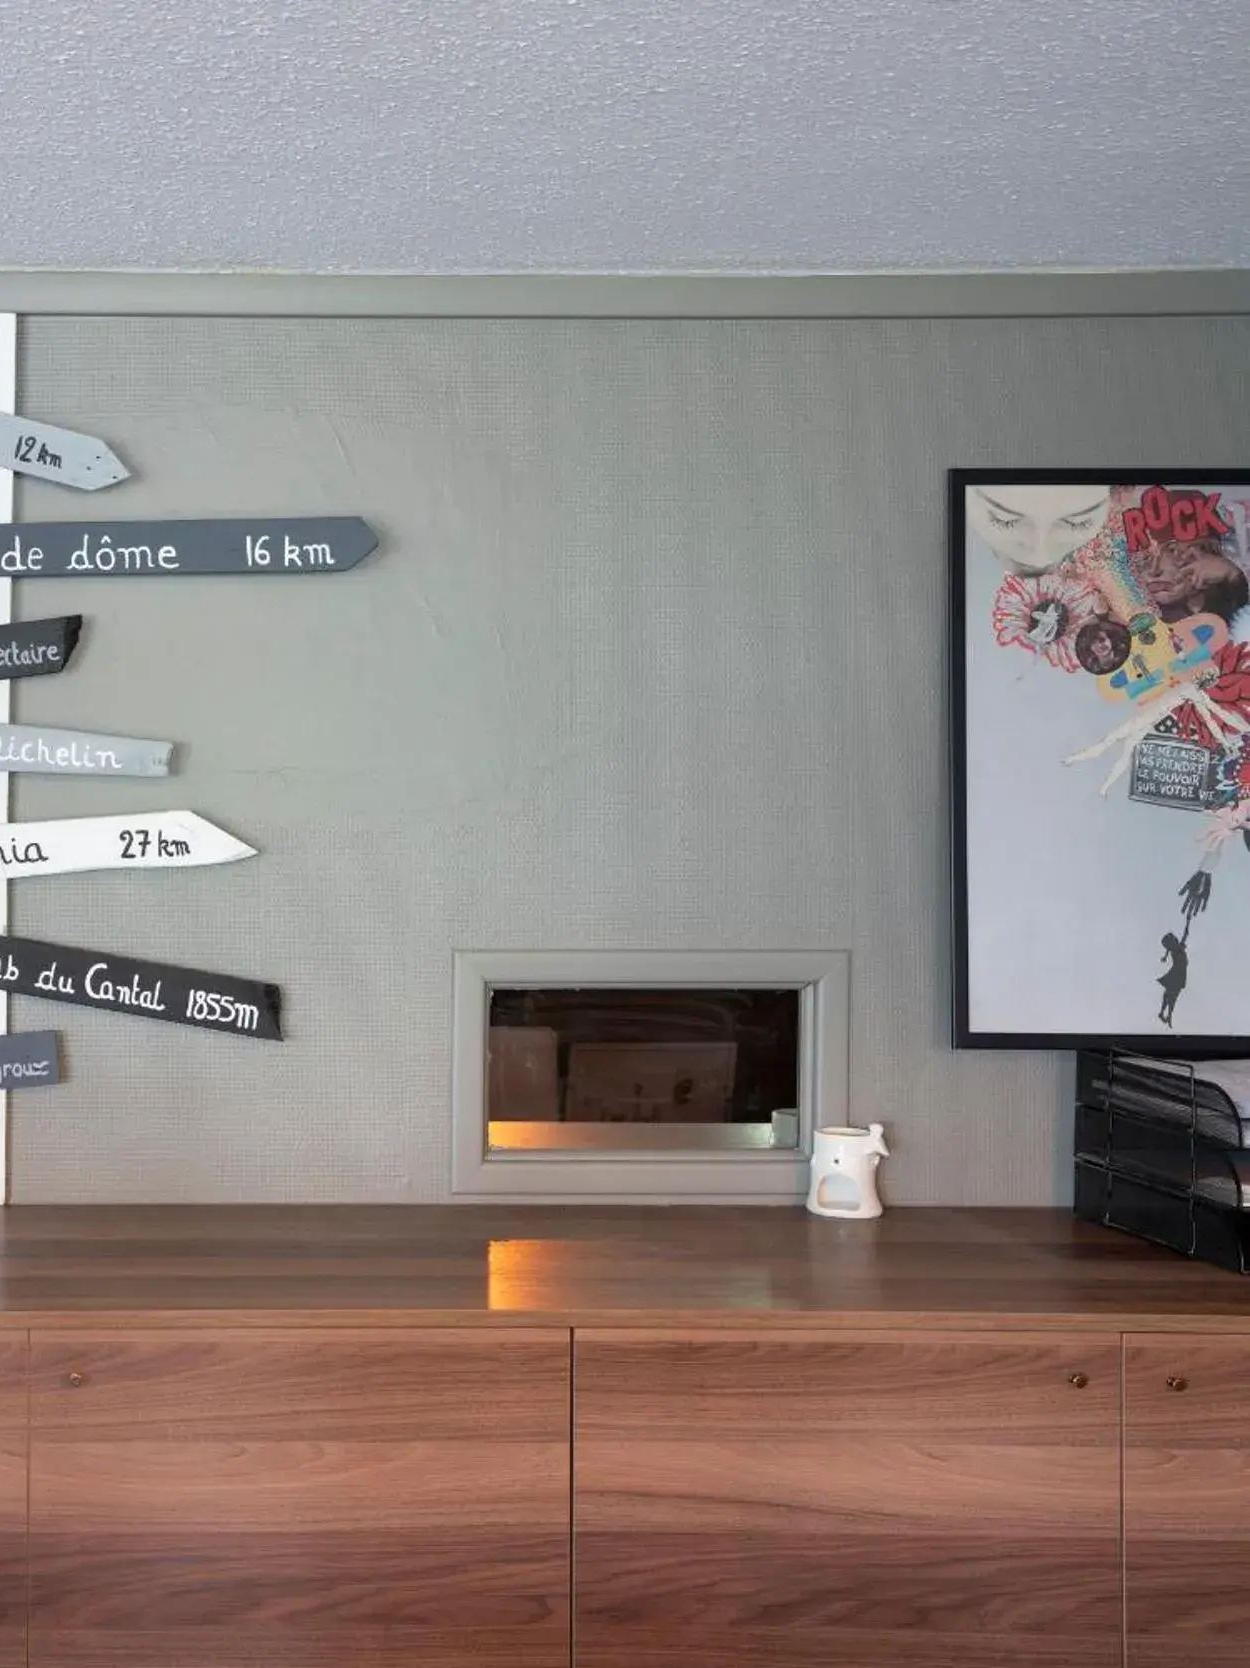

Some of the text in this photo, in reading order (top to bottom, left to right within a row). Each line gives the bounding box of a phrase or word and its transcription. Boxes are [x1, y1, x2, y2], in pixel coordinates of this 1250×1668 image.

[1123, 484, 1228, 552] ROCK
[1, 534, 44, 571] de
[66, 533, 180, 570] dôme
[245, 535, 271, 567] 16
[284, 534, 335, 567] km
[34, 962, 75, 994] du
[84, 963, 166, 1011] Cantal
